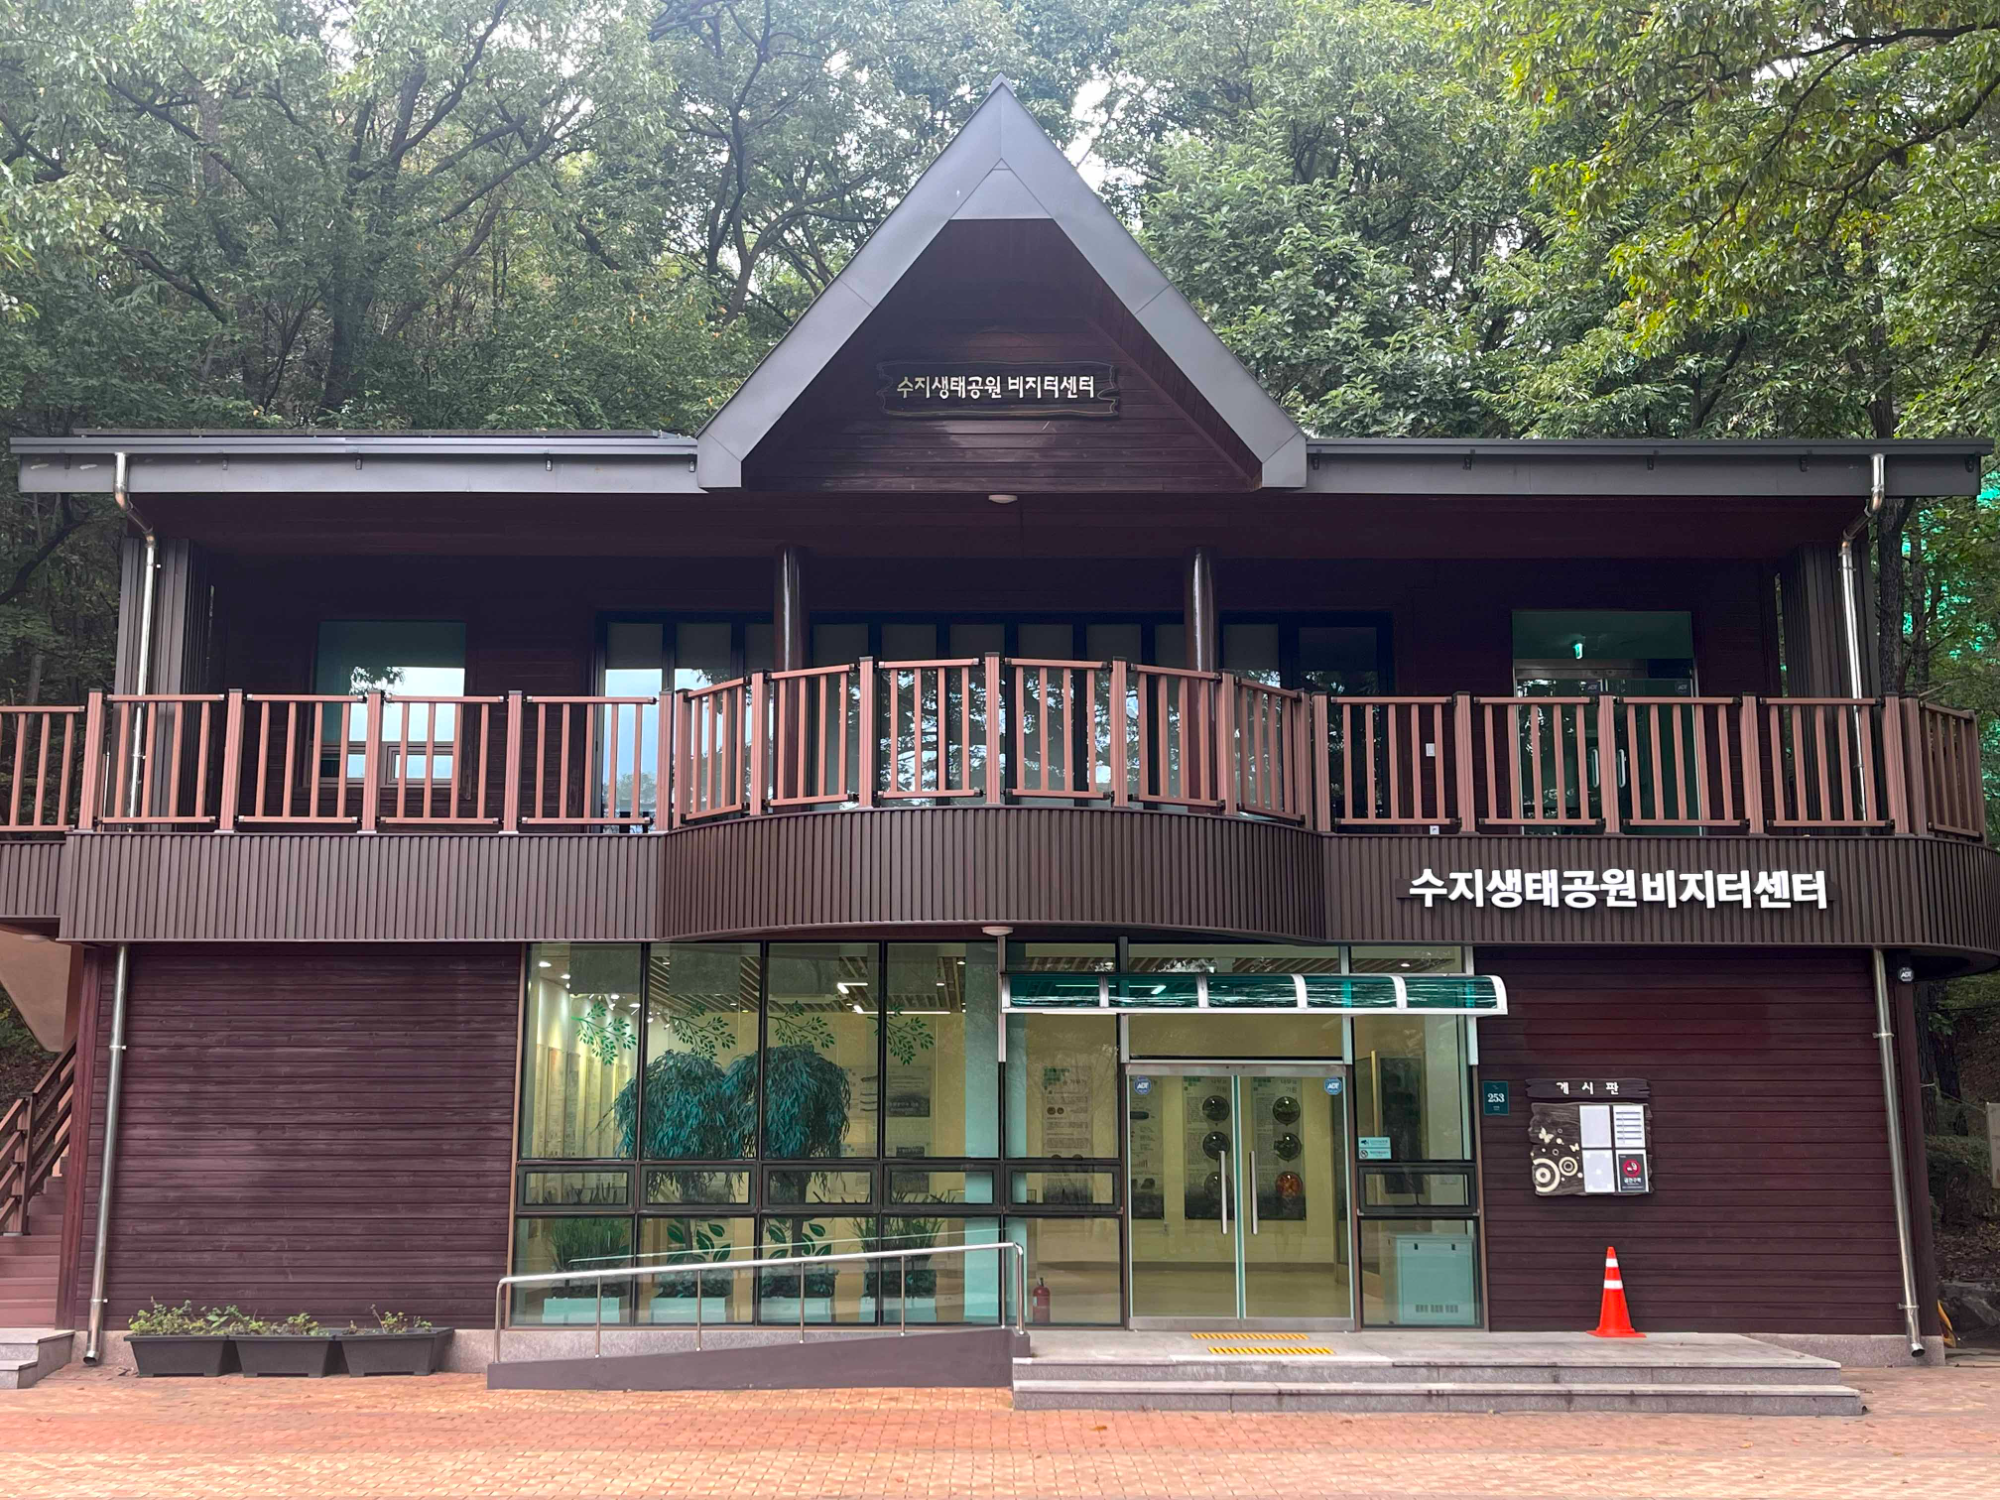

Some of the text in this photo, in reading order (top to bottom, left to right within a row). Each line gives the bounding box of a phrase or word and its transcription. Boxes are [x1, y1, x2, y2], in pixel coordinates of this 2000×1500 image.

[896, 375, 1095, 399] 수지생태공원 비지터센터
[1487, 1092, 1505, 1103] 253
